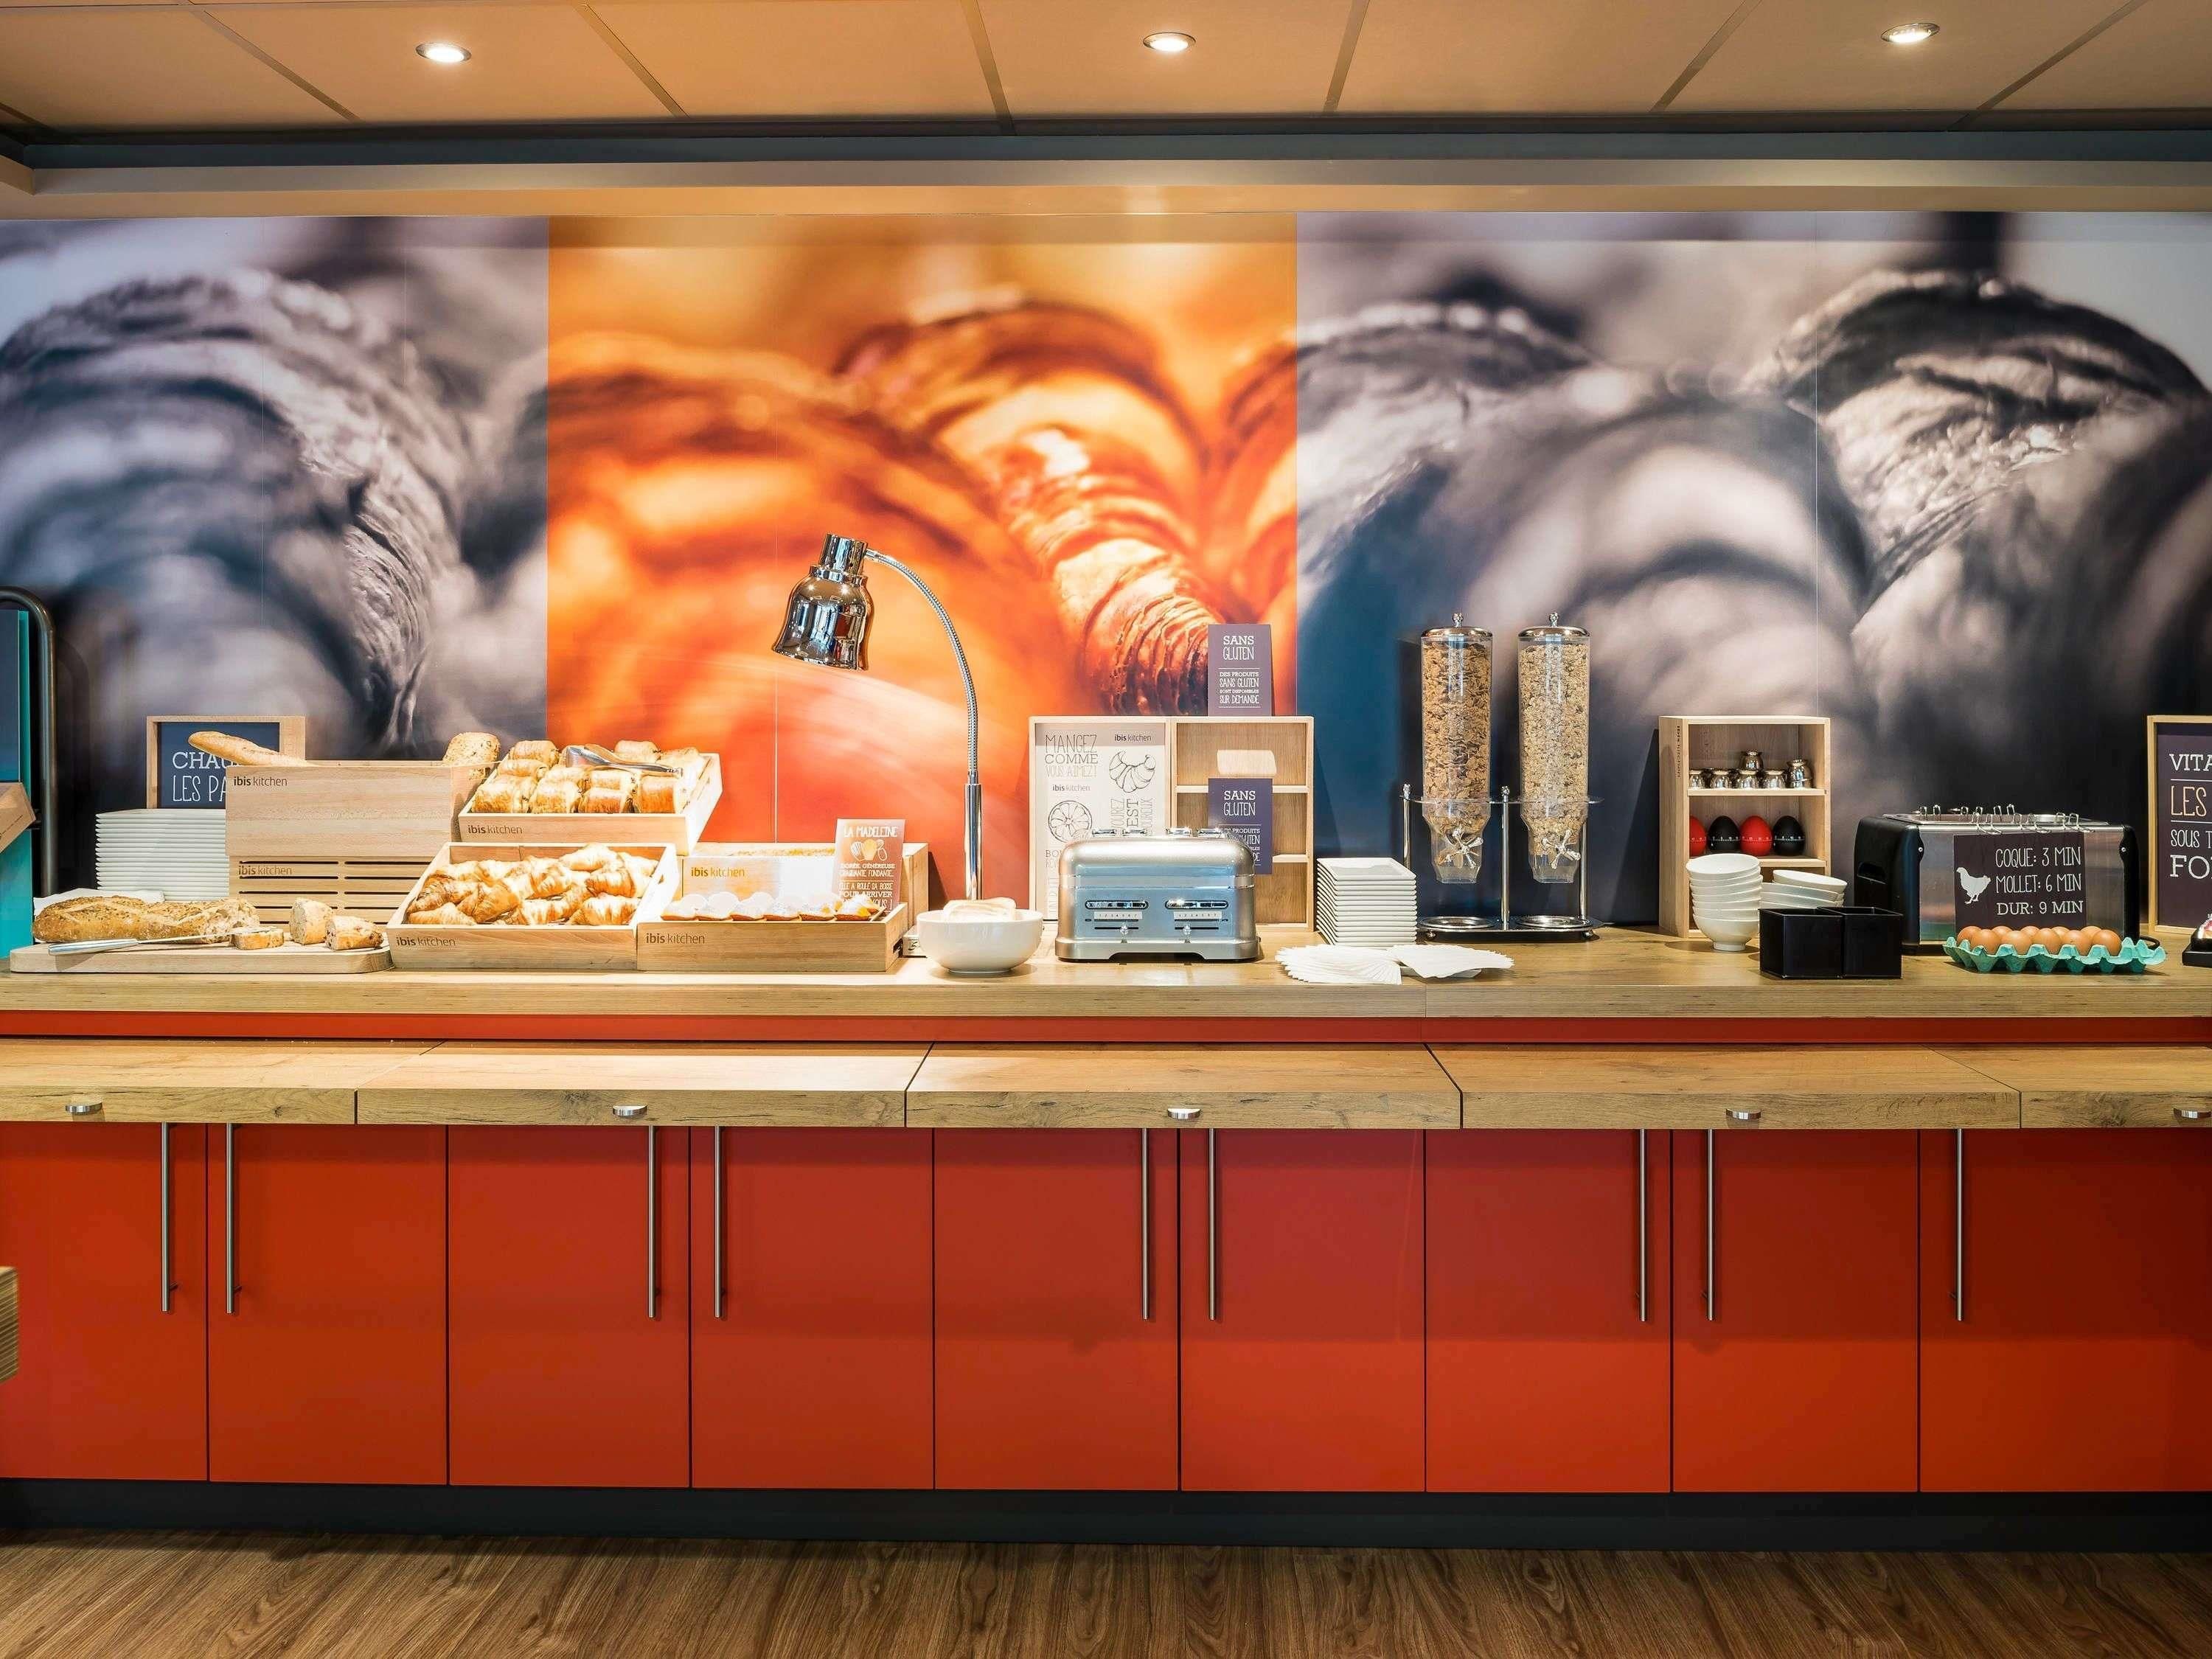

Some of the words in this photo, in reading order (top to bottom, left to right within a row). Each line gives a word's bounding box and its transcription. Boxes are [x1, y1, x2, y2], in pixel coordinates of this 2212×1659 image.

[1223, 636, 1254, 645] SANS
[1223, 646, 1254, 660] GLUTEN
[1219, 678, 1235, 687] SANS
[1237, 678, 1259, 687] GLUTEN
[1220, 695, 1230, 703] SUR
[1231, 695, 1259, 703] DEMANDE
[1114, 734, 1127, 742] ibis
[1127, 734, 1151, 742] kitchen
[1046, 734, 1097, 754] MANGEZ
[1045, 754, 1098, 764] COMME
[234, 776, 251, 786] ibis
[253, 776, 288, 787] kitchen
[173, 775, 201, 801] LES
[1052, 784, 1065, 792] ibis
[1065, 784, 1091, 792] kitchen
[1224, 790, 1256, 801] SANS
[2171, 785, 2207, 817] LES
[1224, 801, 1256, 816] GLUTEN
[467, 824, 486, 834] ibis
[487, 824, 523, 834] kitchen
[844, 826, 853, 838] LA
[855, 826, 897, 838] MADELEINE
[2171, 829, 2200, 849] SOUS
[1995, 848, 2037, 868] COQUE:
[2042, 847, 2050, 866] 3
[2054, 846, 2081, 866] MIN
[238, 865, 256, 875] ibis
[257, 865, 292, 875] kitchen
[691, 867, 709, 877] ibis
[710, 867, 745, 877] kitchen
[2169, 855, 2212, 880] FO
[1996, 874, 2041, 894] MOLLET:
[2045, 874, 2053, 892] 6
[2056, 873, 2081, 892] MIN
[1996, 902, 2034, 915] DUR:
[2039, 901, 2047, 914] 9
[2051, 900, 2084, 914] MIN
[396, 936, 416, 946] ibis
[417, 936, 456, 947] kitchen
[646, 933, 665, 944] ibis
[667, 933, 705, 945] kitchen
